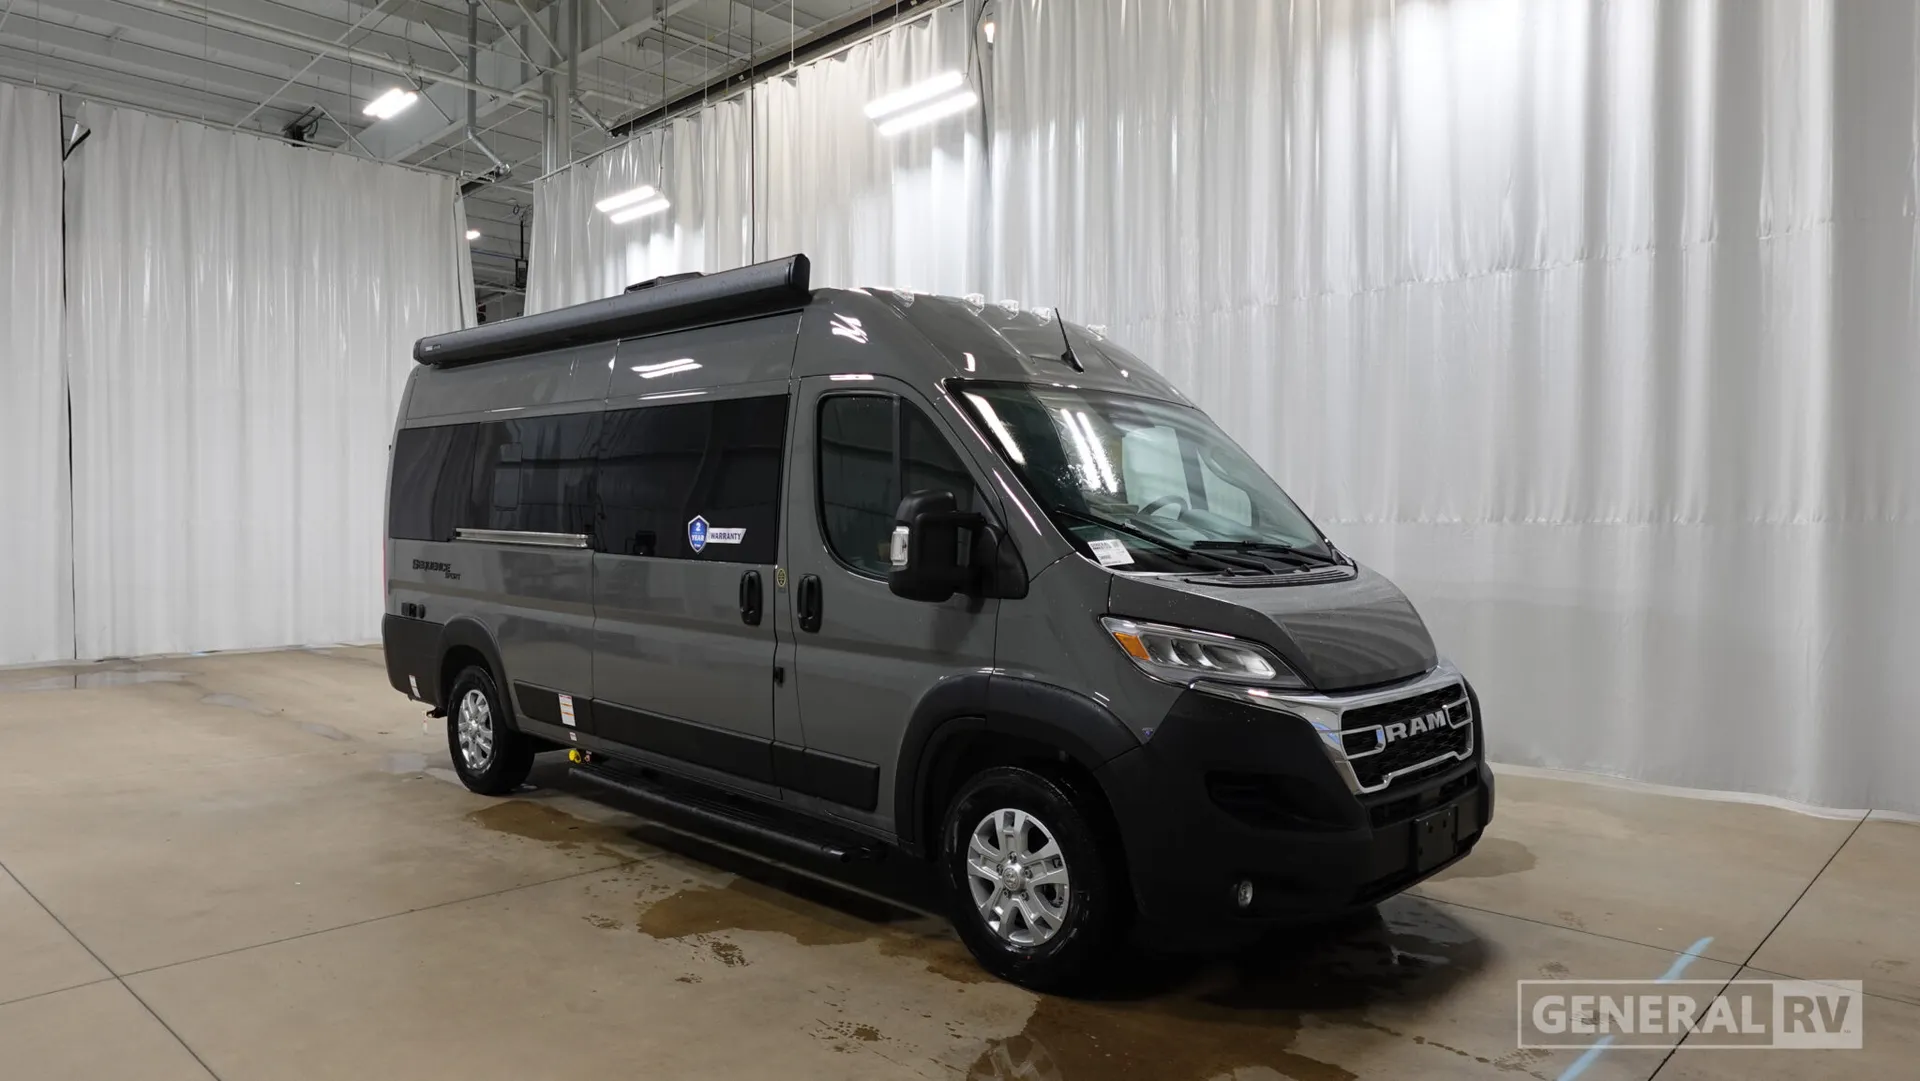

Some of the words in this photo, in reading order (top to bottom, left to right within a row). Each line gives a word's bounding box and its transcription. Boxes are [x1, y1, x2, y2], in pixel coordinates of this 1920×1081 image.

[695, 521, 701, 532] 2
[710, 532, 742, 540] WARRANTY
[1384, 709, 1447, 743] RAM
